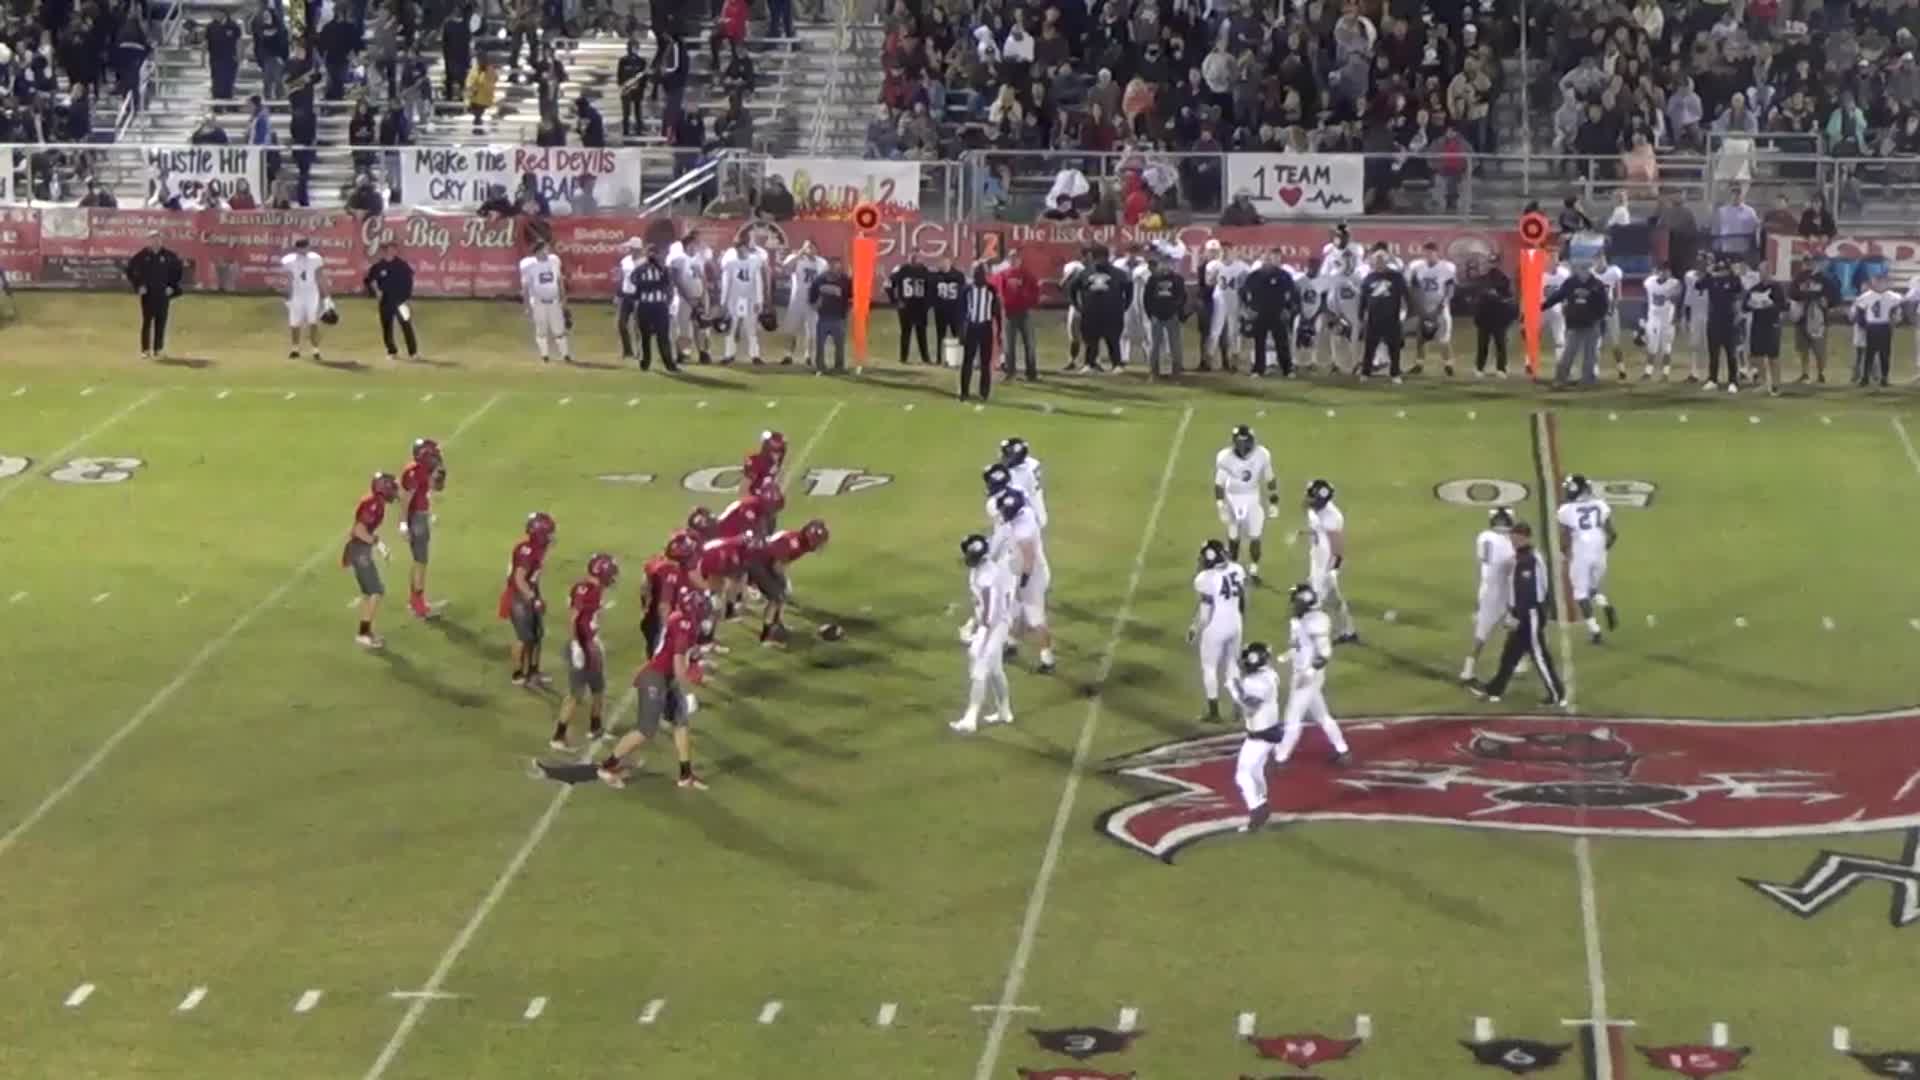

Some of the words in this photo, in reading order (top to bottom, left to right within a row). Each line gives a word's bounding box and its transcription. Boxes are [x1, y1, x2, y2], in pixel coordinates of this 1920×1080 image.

[148, 148, 213, 174] Hustle
[219, 148, 248, 174] Hit
[415, 149, 469, 175] Make
[477, 149, 506, 172] the
[514, 149, 549, 173] Red
[556, 148, 616, 175] Devils
[429, 177, 465, 201] CRY
[1249, 167, 1273, 201] 1
[1275, 163, 1331, 185] TEAM
[361, 216, 394, 256] Go
[404, 216, 450, 256] Big
[460, 216, 515, 248] Red
[982, 232, 999, 257] 2
[1012, 224, 1046, 241] The
[1576, 506, 1604, 530] 27
[1218, 572, 1243, 600] 45
